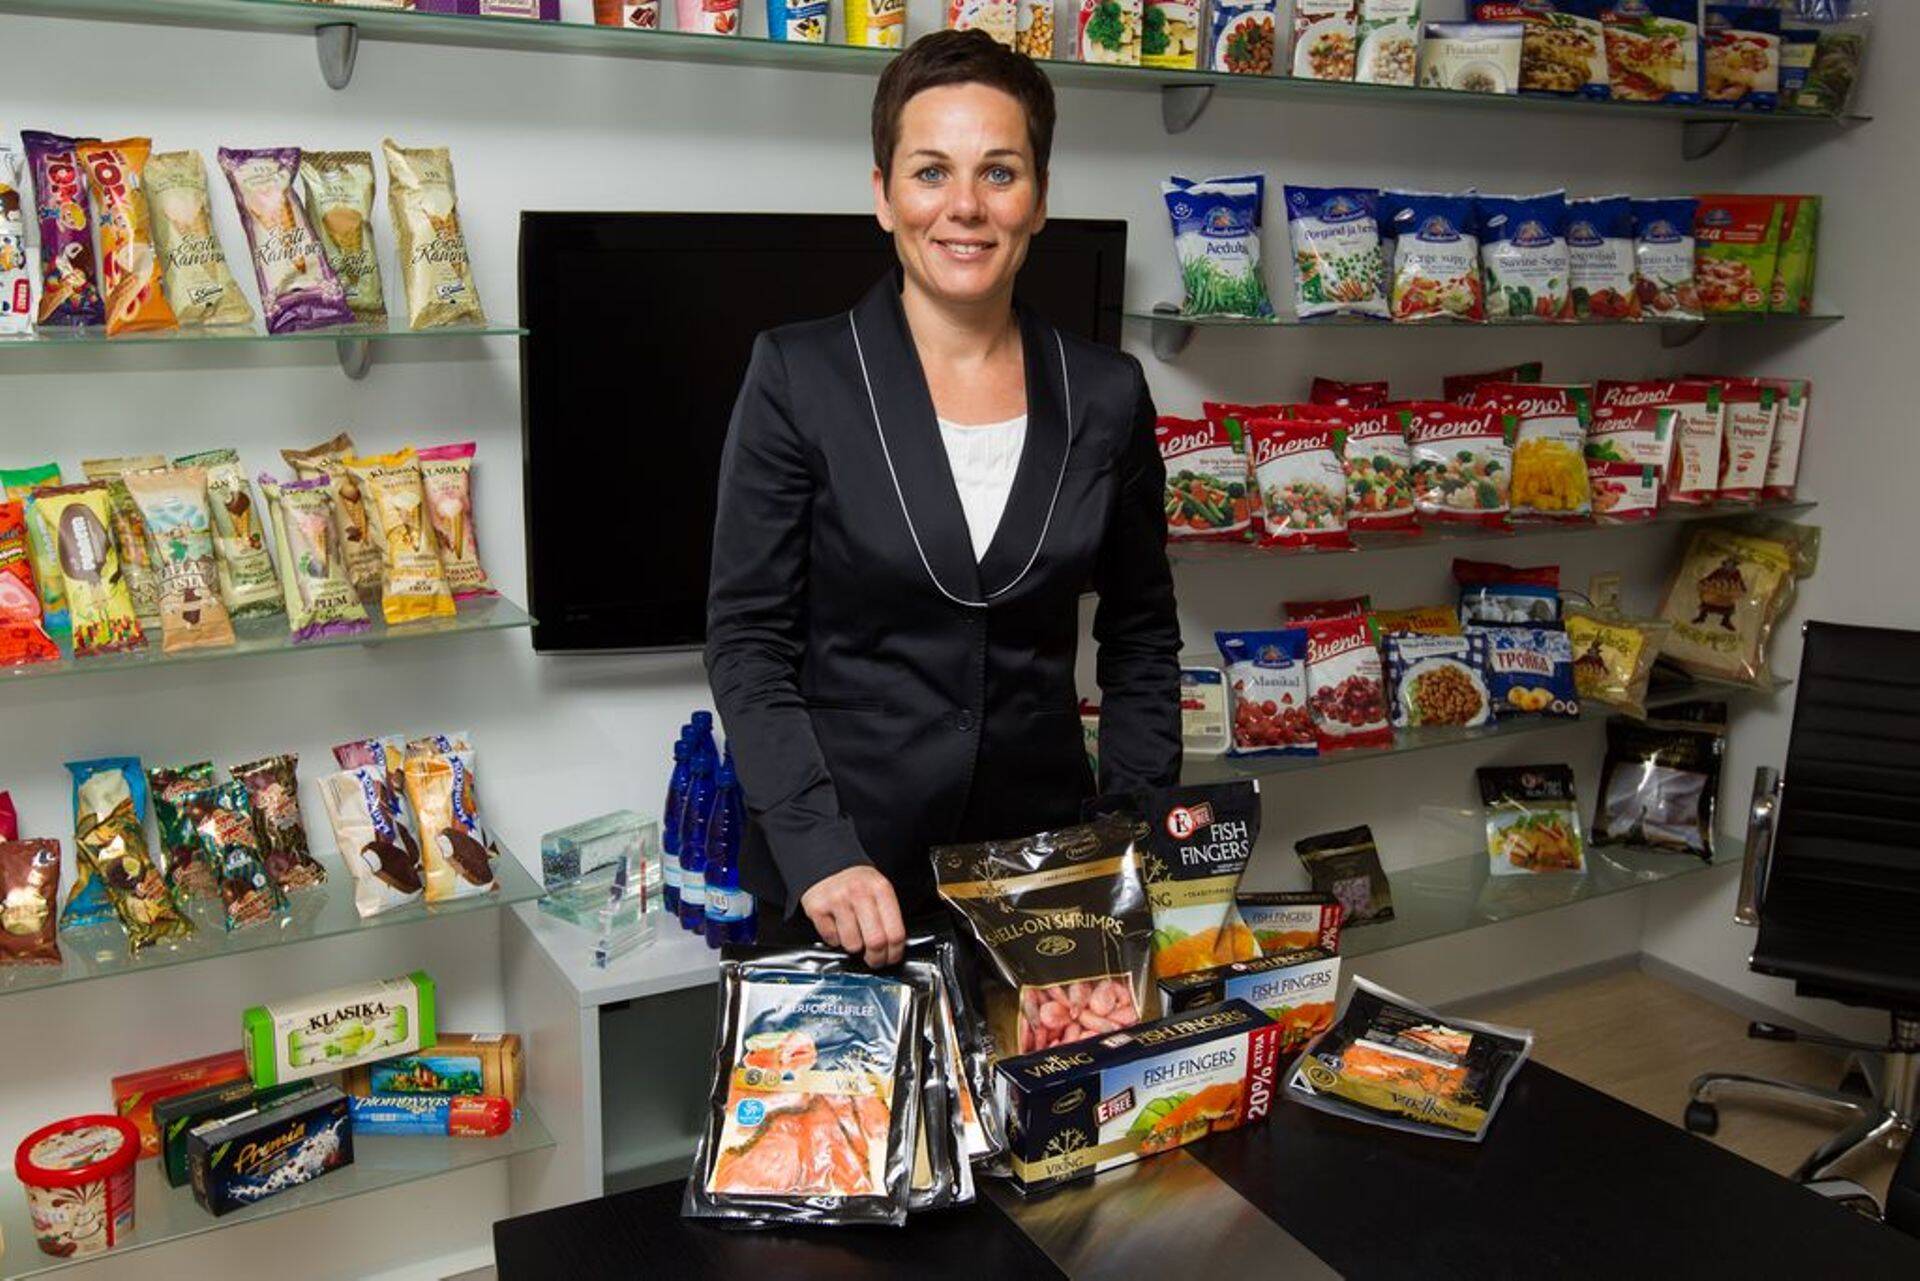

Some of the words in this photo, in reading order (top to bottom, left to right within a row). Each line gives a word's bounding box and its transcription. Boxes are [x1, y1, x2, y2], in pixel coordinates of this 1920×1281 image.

[1408, 413, 1493, 441] Bueno!
[1256, 431, 1329, 463] Bueno!
[1210, 820, 1248, 842] FISH
[1180, 840, 1250, 866] FINGERS
[1053, 912, 1124, 938] SHRIMPS
[1252, 982, 1279, 1000] FISH
[1281, 971, 1332, 993] FINGERS
[309, 1001, 387, 1030] KLASIKA
[1024, 1053, 1095, 1079] VIKING
[1143, 1064, 1176, 1087] FISH
[1178, 1048, 1237, 1075] FINGERS
[1247, 1066, 1273, 1120] 20%
